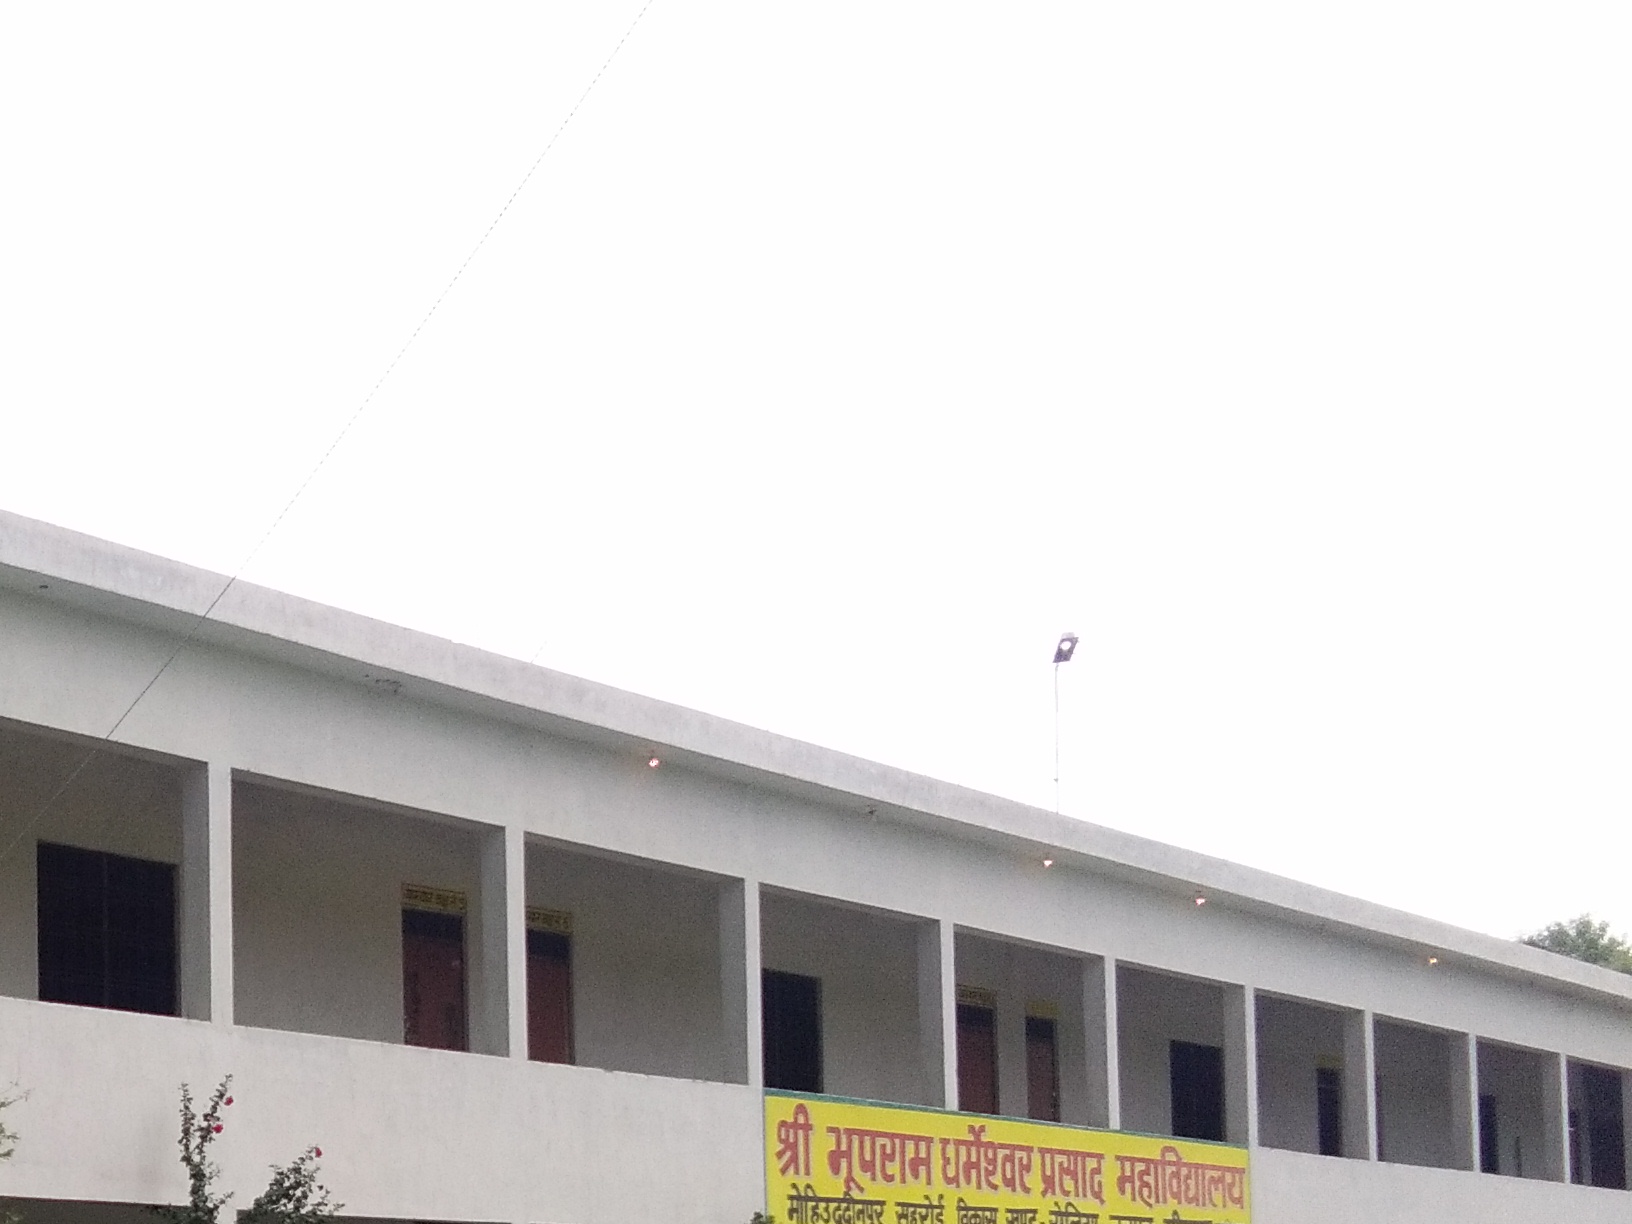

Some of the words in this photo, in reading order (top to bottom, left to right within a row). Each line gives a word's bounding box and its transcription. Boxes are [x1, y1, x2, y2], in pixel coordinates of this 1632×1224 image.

[775, 1103, 814, 1177] श्री
[826, 1126, 934, 1194] भूपराम
[939, 1124, 1034, 1195] धर्मेश्वर
[1037, 1147, 1106, 1206] प्रसाद
[1115, 1146, 1246, 1209] महाविद्यालय
